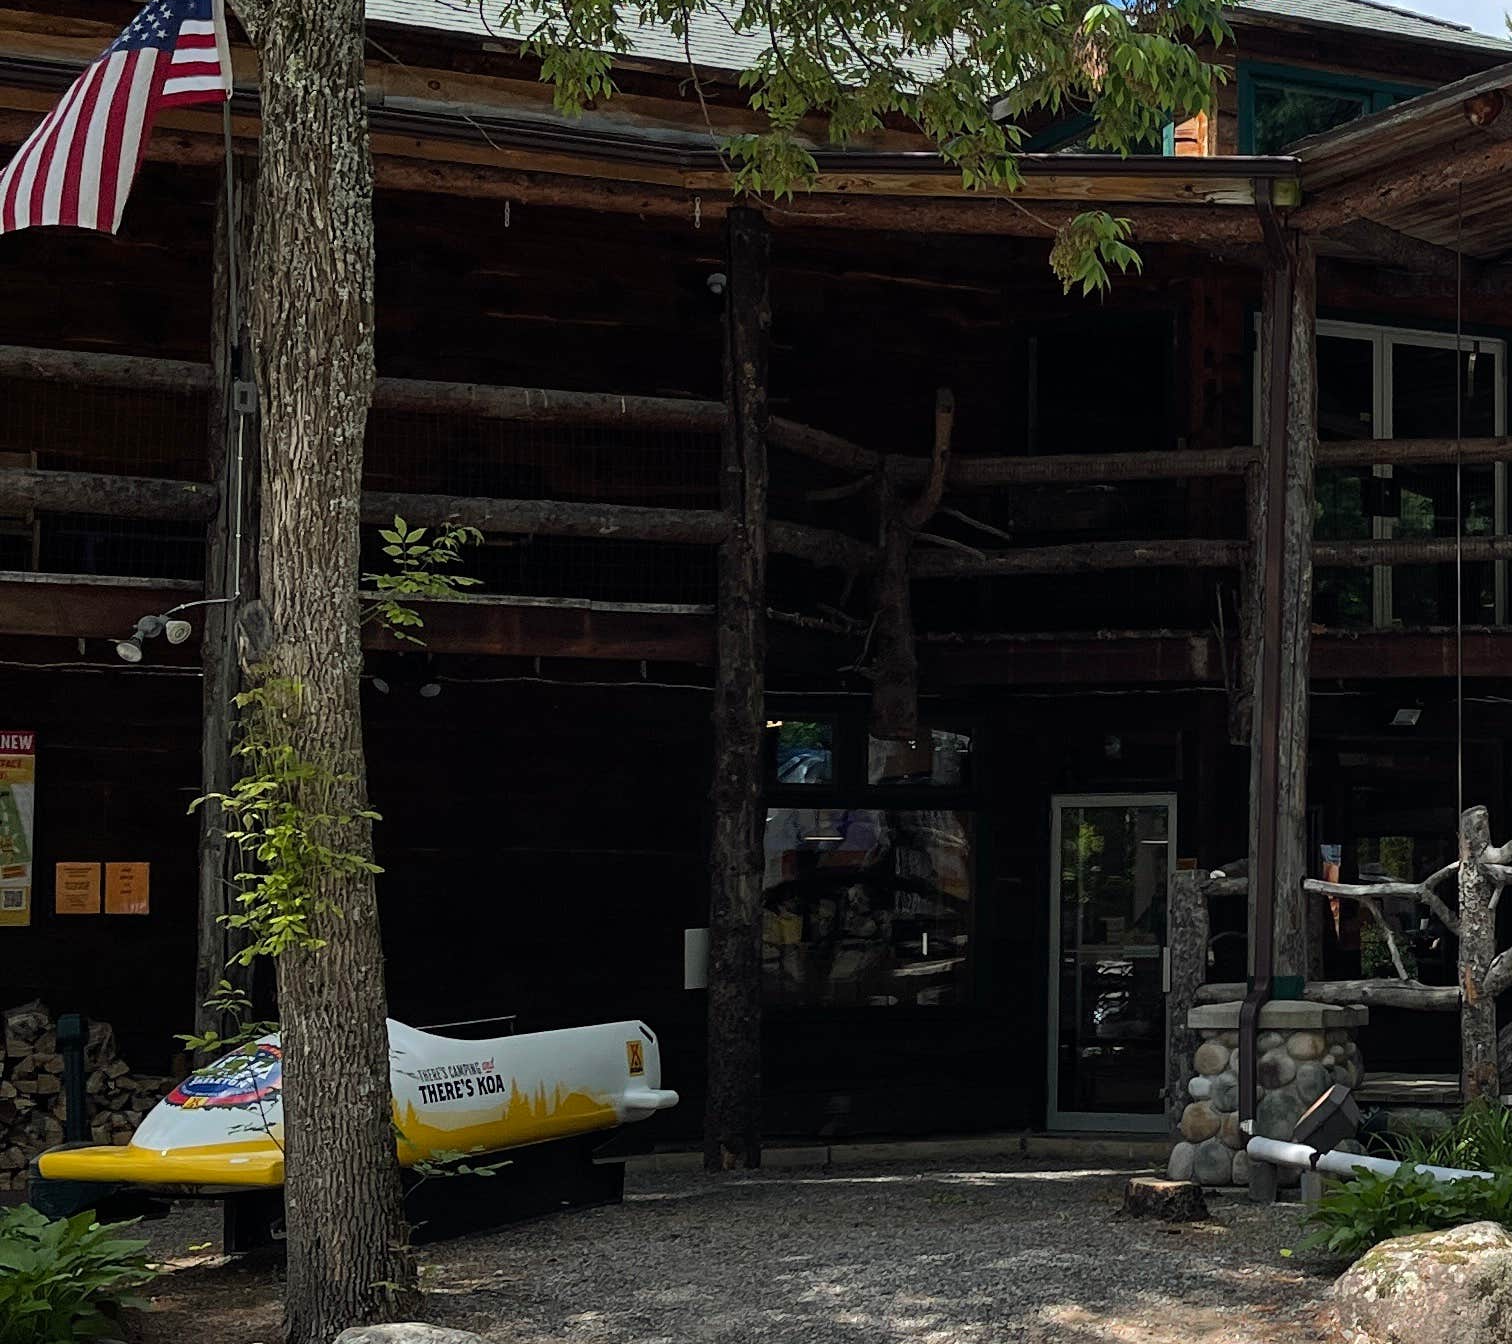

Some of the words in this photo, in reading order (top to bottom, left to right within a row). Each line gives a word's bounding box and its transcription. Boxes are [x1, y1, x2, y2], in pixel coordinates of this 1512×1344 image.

[1, 735, 33, 750] NEW
[417, 1065, 448, 1083] THERE'S
[448, 1061, 482, 1079] CAMPING
[418, 1078, 475, 1105] THERE'S
[476, 1074, 506, 1096] KOA
